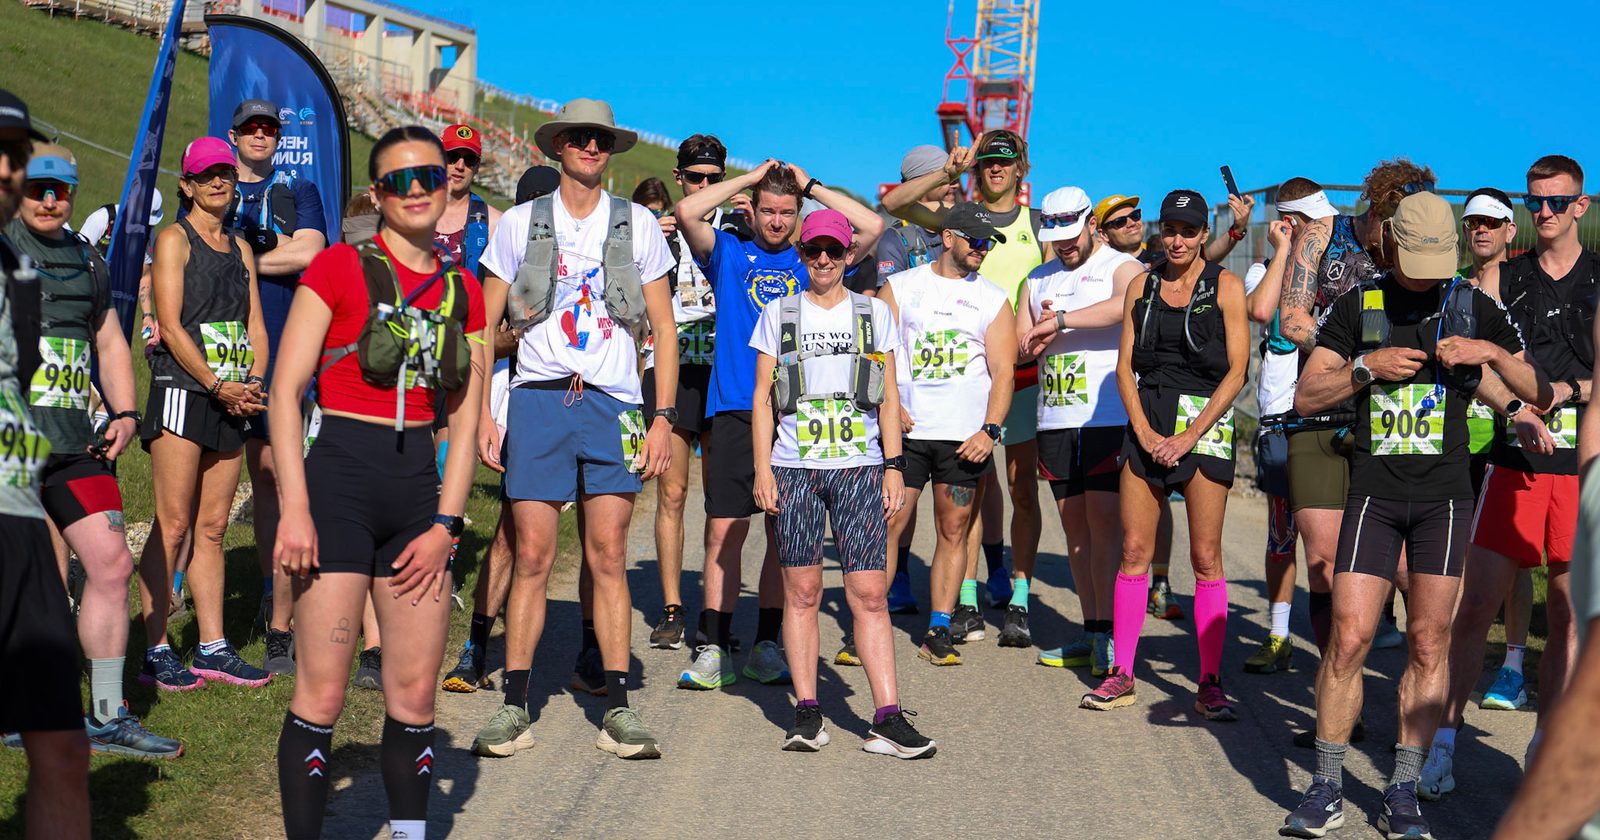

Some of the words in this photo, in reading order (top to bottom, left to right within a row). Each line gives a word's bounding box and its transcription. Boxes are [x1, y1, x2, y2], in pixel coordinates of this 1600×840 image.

[216, 342, 247, 368] 942
[679, 335, 715, 357] 915
[920, 347, 955, 368] 951
[45, 363, 85, 394] 930
[1046, 372, 1076, 395] 912
[808, 416, 854, 445] 918
[1381, 409, 1431, 439] 906
